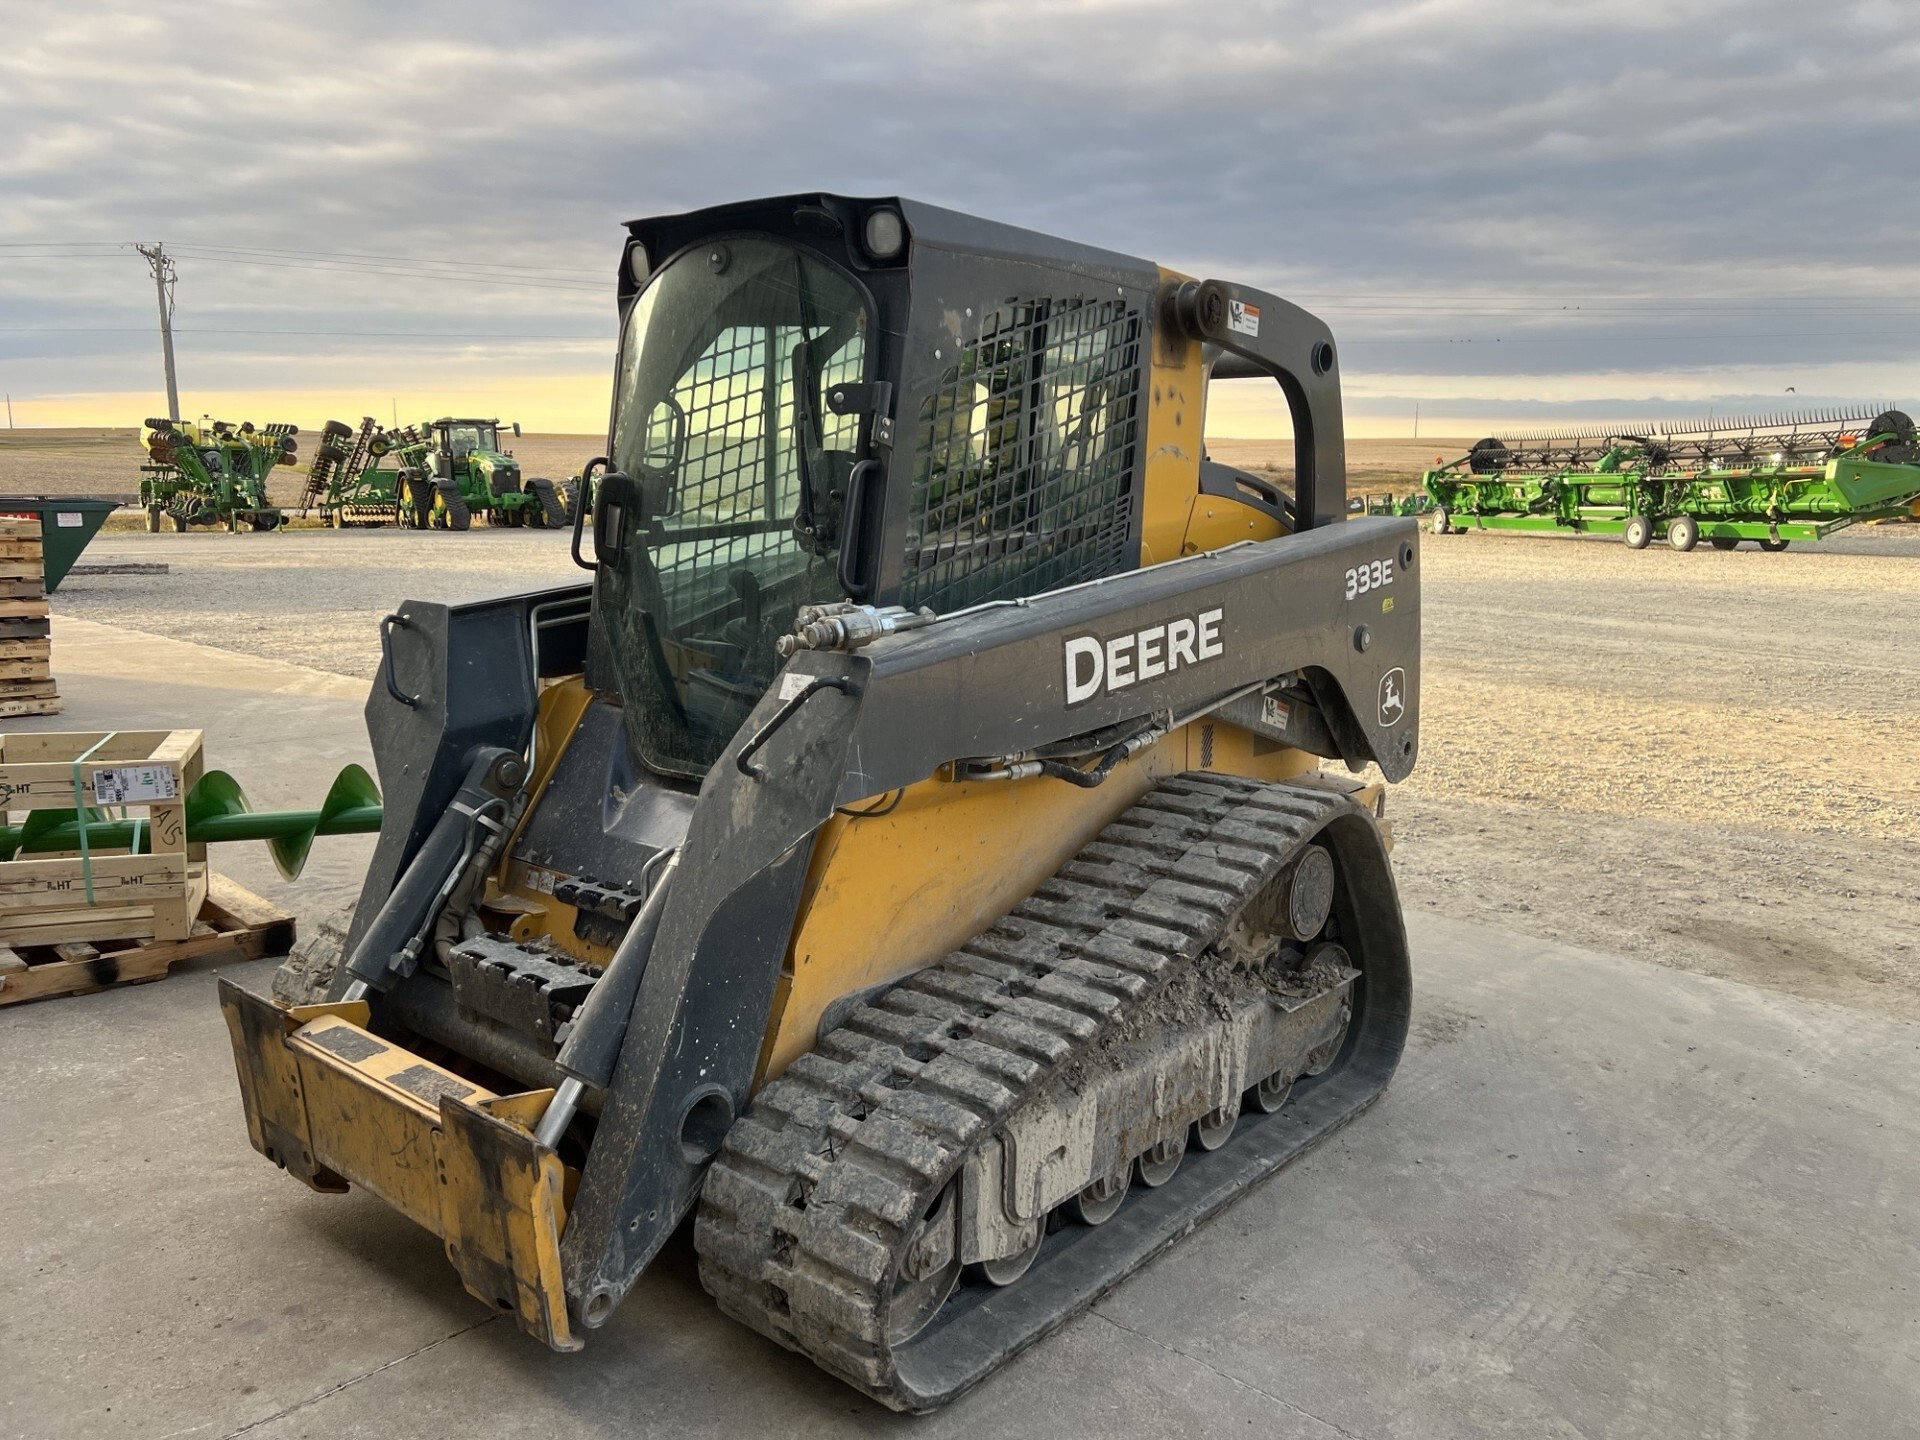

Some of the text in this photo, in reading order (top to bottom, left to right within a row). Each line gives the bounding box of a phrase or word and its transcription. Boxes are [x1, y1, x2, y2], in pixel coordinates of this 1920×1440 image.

[1345, 558, 1393, 601] 333E
[1065, 608, 1223, 705] DEERE
[16, 784, 31, 794] HT
[57, 880, 72, 890] HT
[130, 875, 144, 885] HT
